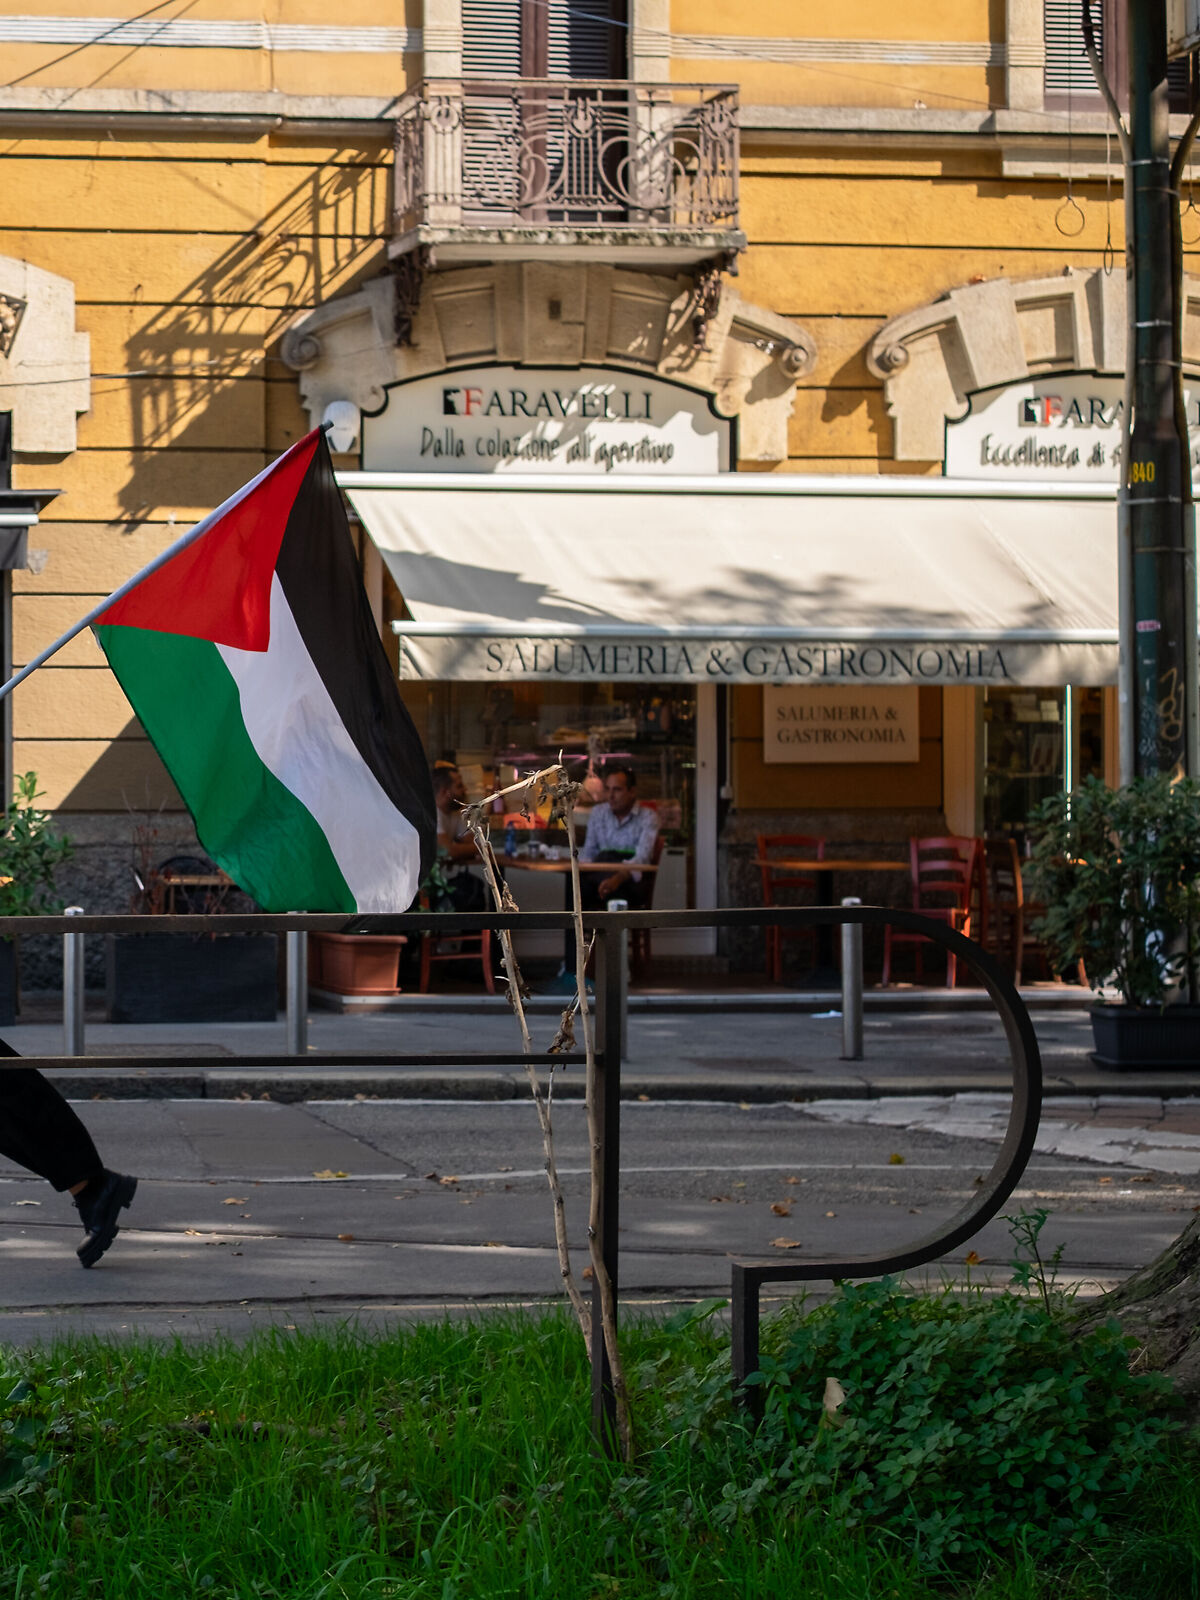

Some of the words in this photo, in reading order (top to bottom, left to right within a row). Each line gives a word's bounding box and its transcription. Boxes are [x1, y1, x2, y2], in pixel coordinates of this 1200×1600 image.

[463, 388, 653, 419] FARAVELLI
[420, 426, 466, 458] Dalla
[476, 429, 561, 460] colazione
[981, 433, 1080, 467] Eccellenza
[1128, 461, 1155, 483] 840
[486, 642, 696, 675] SALUMERIA
[705, 647, 733, 677] &
[742, 645, 1010, 679] GASTRONOMIA
[777, 705, 880, 722] SALUMERIA
[885, 708, 898, 721] &
[777, 727, 906, 744] GASTRONOMIA
